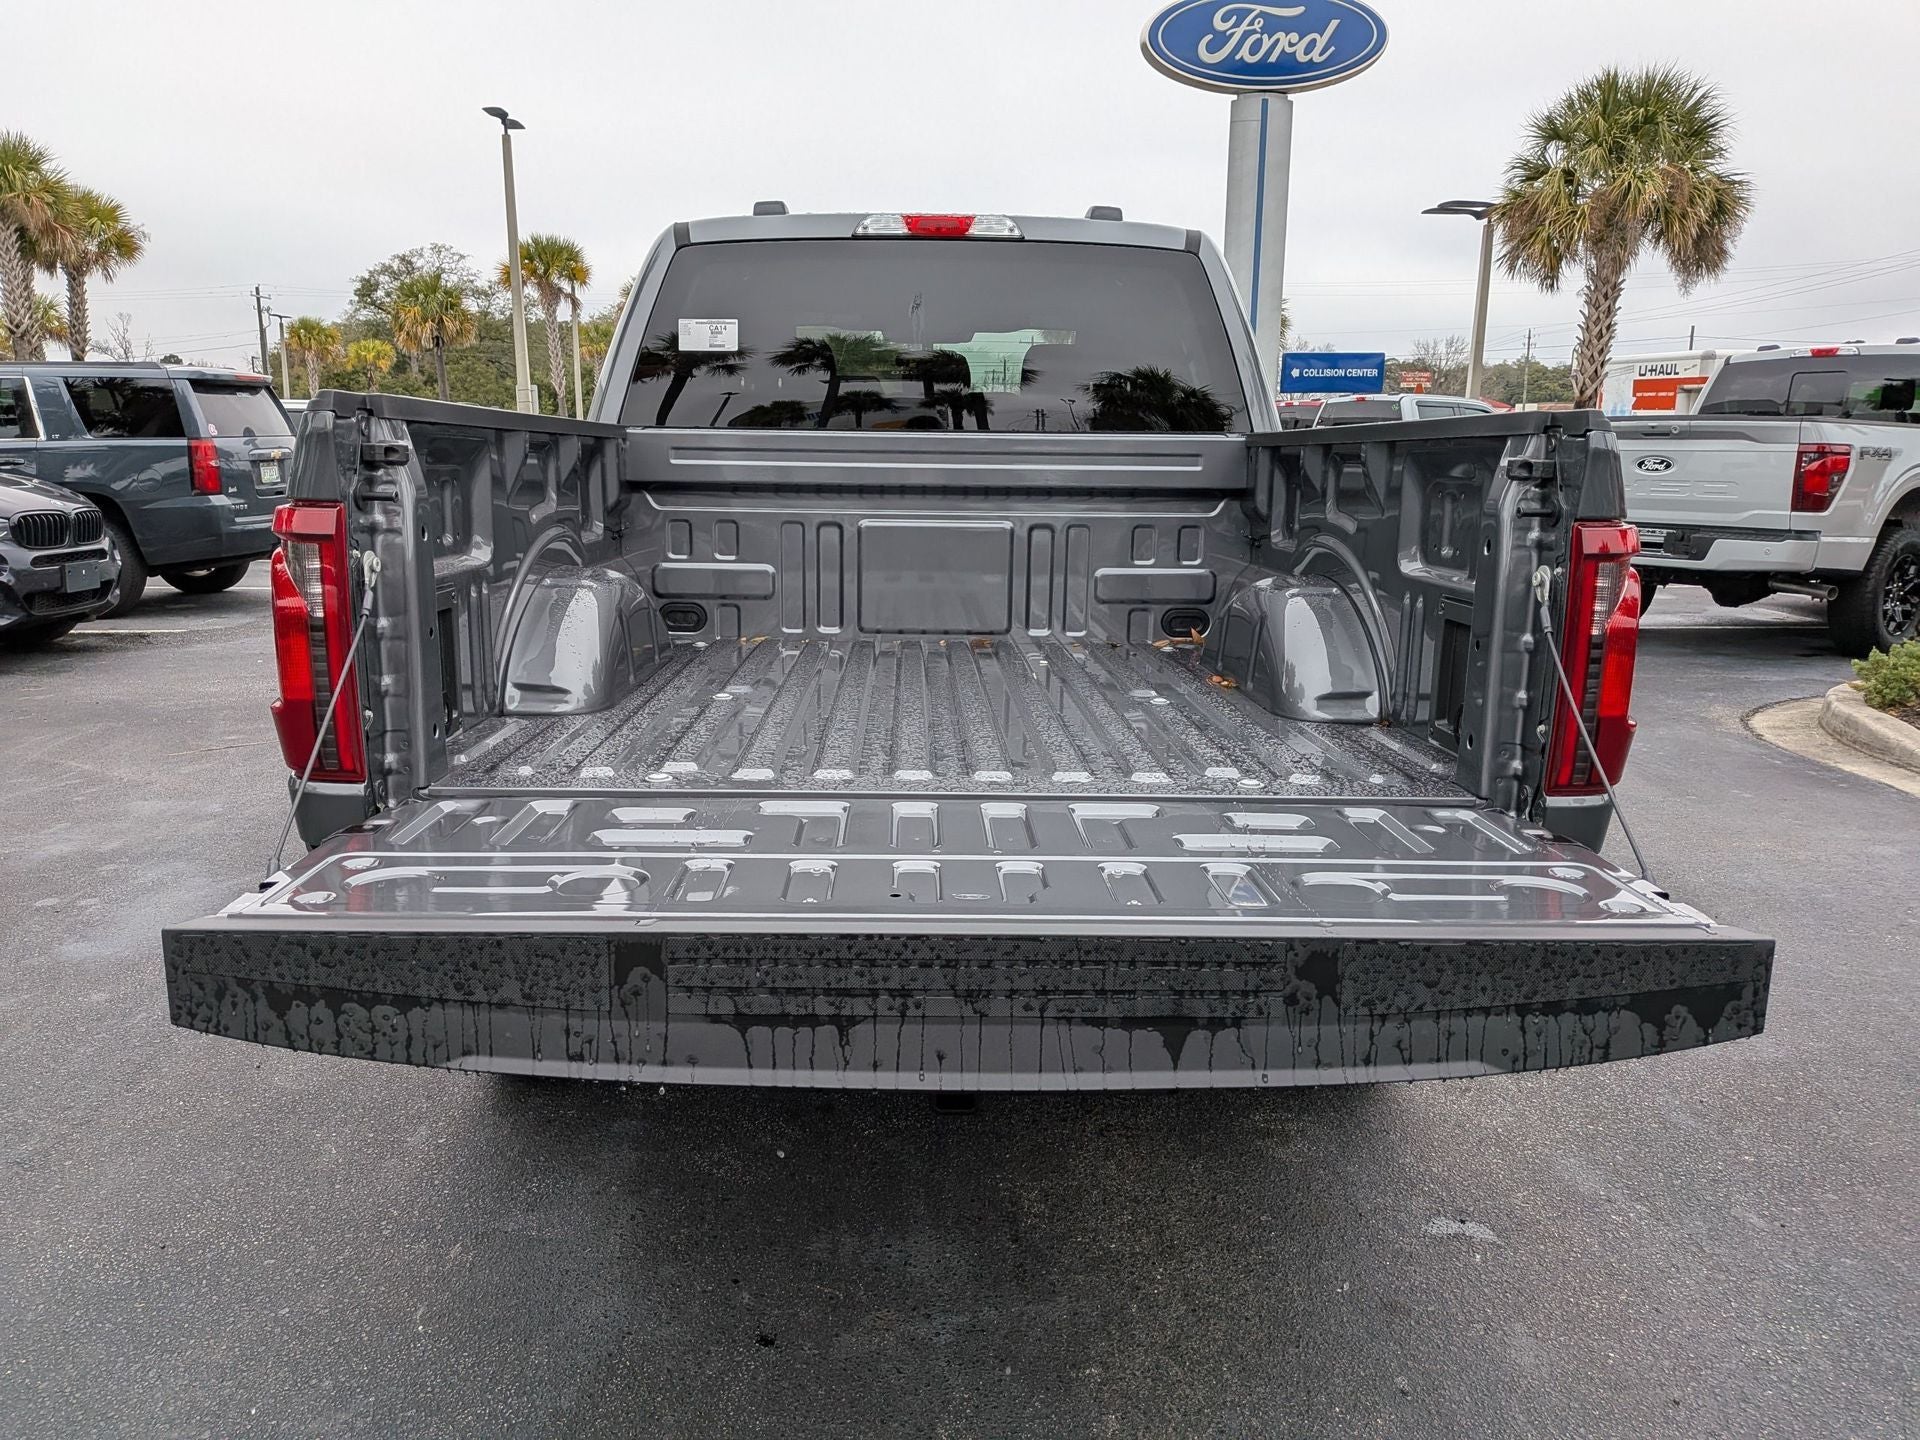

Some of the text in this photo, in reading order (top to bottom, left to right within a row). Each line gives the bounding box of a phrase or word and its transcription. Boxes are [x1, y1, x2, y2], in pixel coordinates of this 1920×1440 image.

[1197, 3, 1342, 65] Ford
[1303, 368, 1378, 377] COLLISION CENTER
[1638, 363, 1680, 378] U-HAUL
[1859, 447, 1893, 460] FX4
[1641, 458, 1667, 471] Ford
